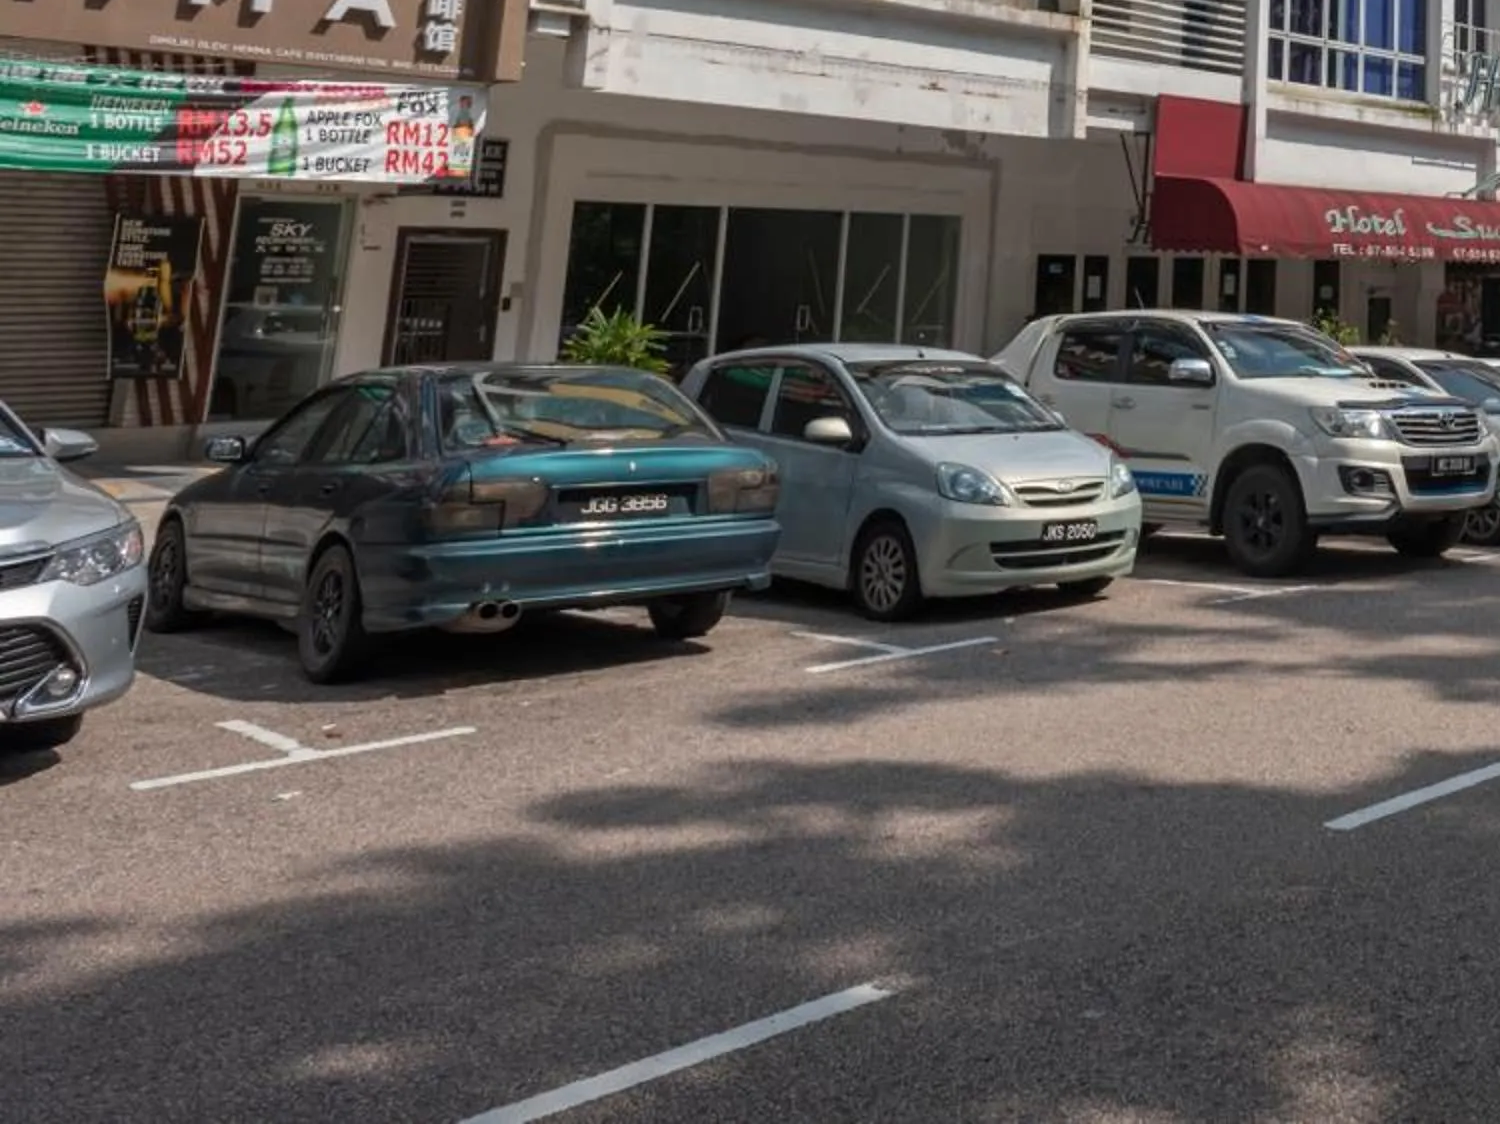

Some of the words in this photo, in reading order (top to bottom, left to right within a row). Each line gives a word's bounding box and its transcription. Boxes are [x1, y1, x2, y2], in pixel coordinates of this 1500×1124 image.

[105, 115, 163, 133] BOTTLE
[177, 107, 272, 138] RM13.5
[306, 109, 351, 126] APPLE
[354, 112, 383, 126] FOX
[319, 129, 373, 144] BOTTLE
[385, 121, 449, 147] RM12
[100, 144, 162, 162] BUCKET
[176, 140, 248, 165] RM52
[315, 156, 372, 172] BUCKET
[1325, 205, 1407, 236] Hotel
